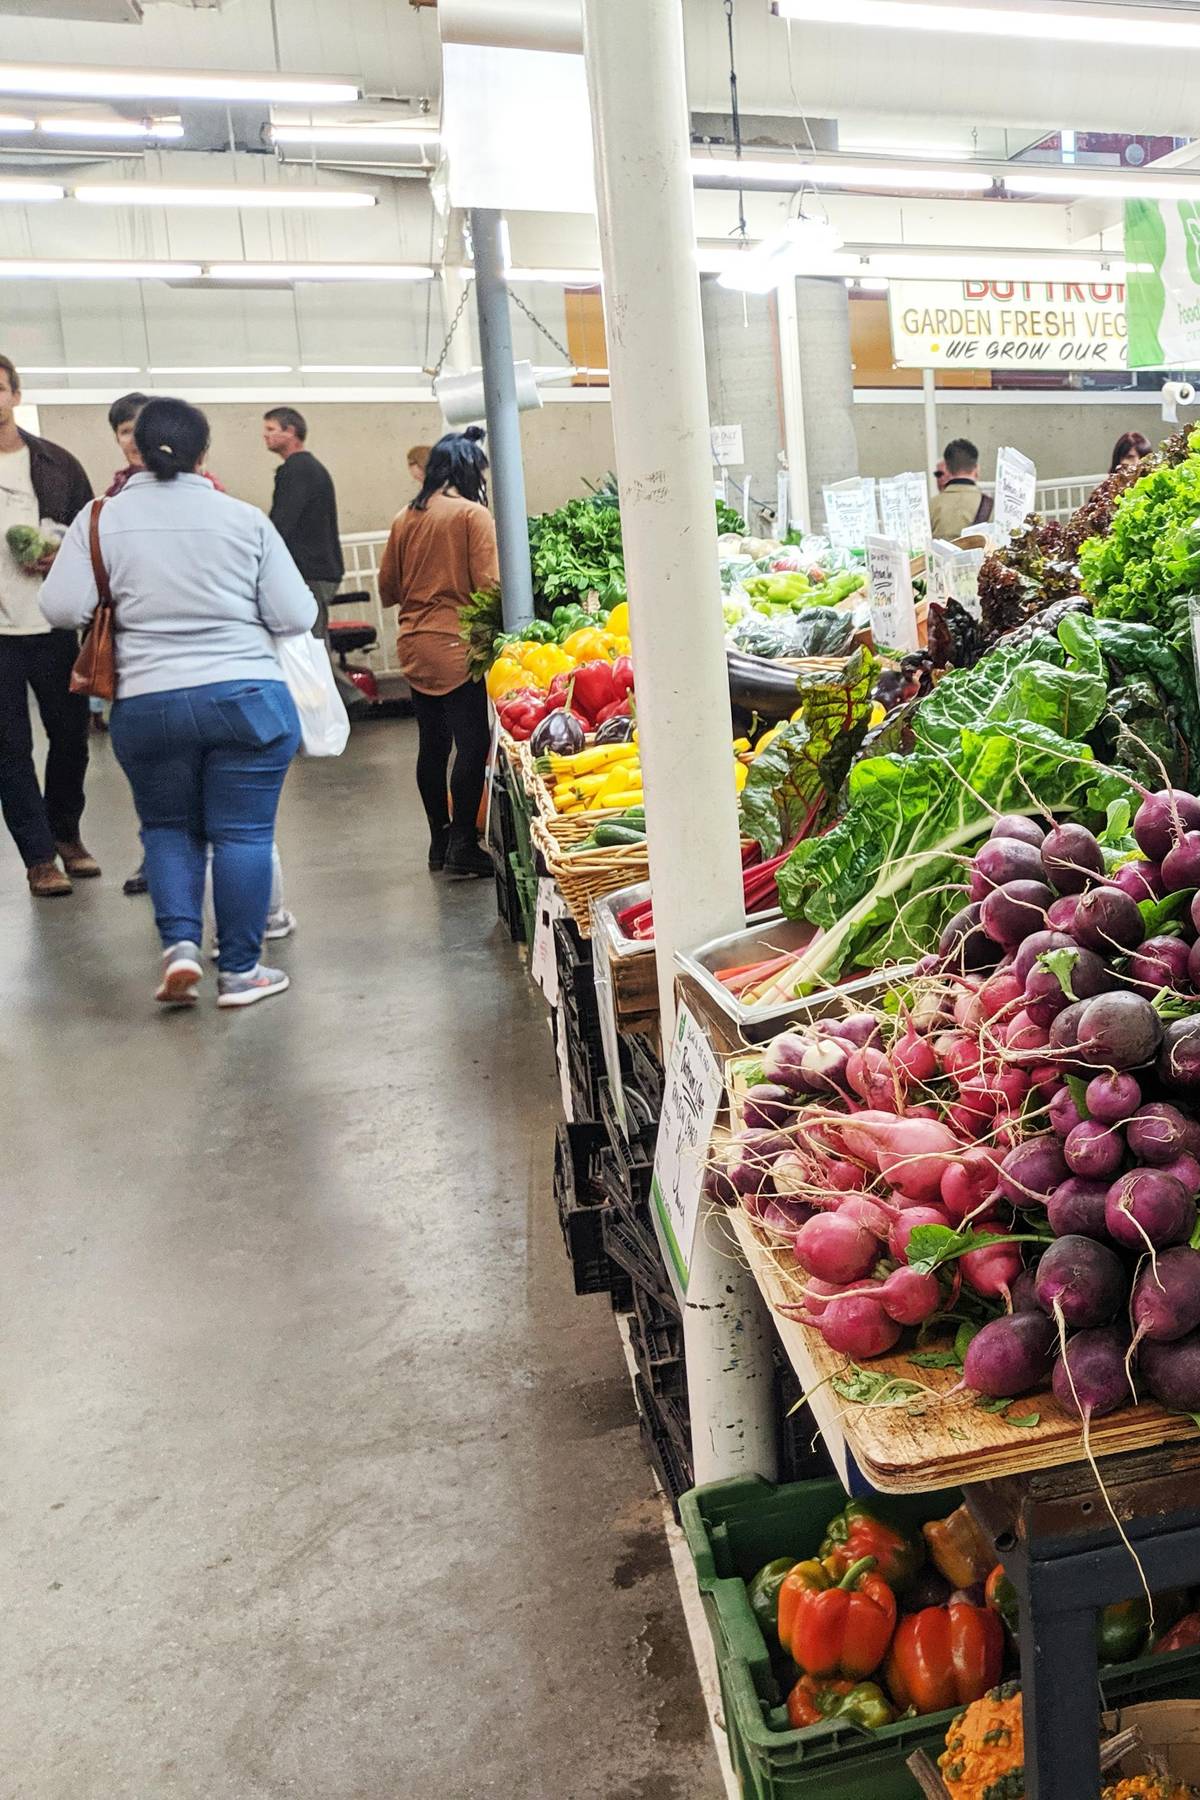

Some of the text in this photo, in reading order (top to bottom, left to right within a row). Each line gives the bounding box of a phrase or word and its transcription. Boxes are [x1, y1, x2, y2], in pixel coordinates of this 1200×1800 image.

[904, 308, 991, 336] GARDEN
[1001, 310, 1077, 337] FRESH
[946, 340, 978, 359] WE
[986, 340, 1049, 361] GROW
[1060, 342, 1107, 362] OUR
